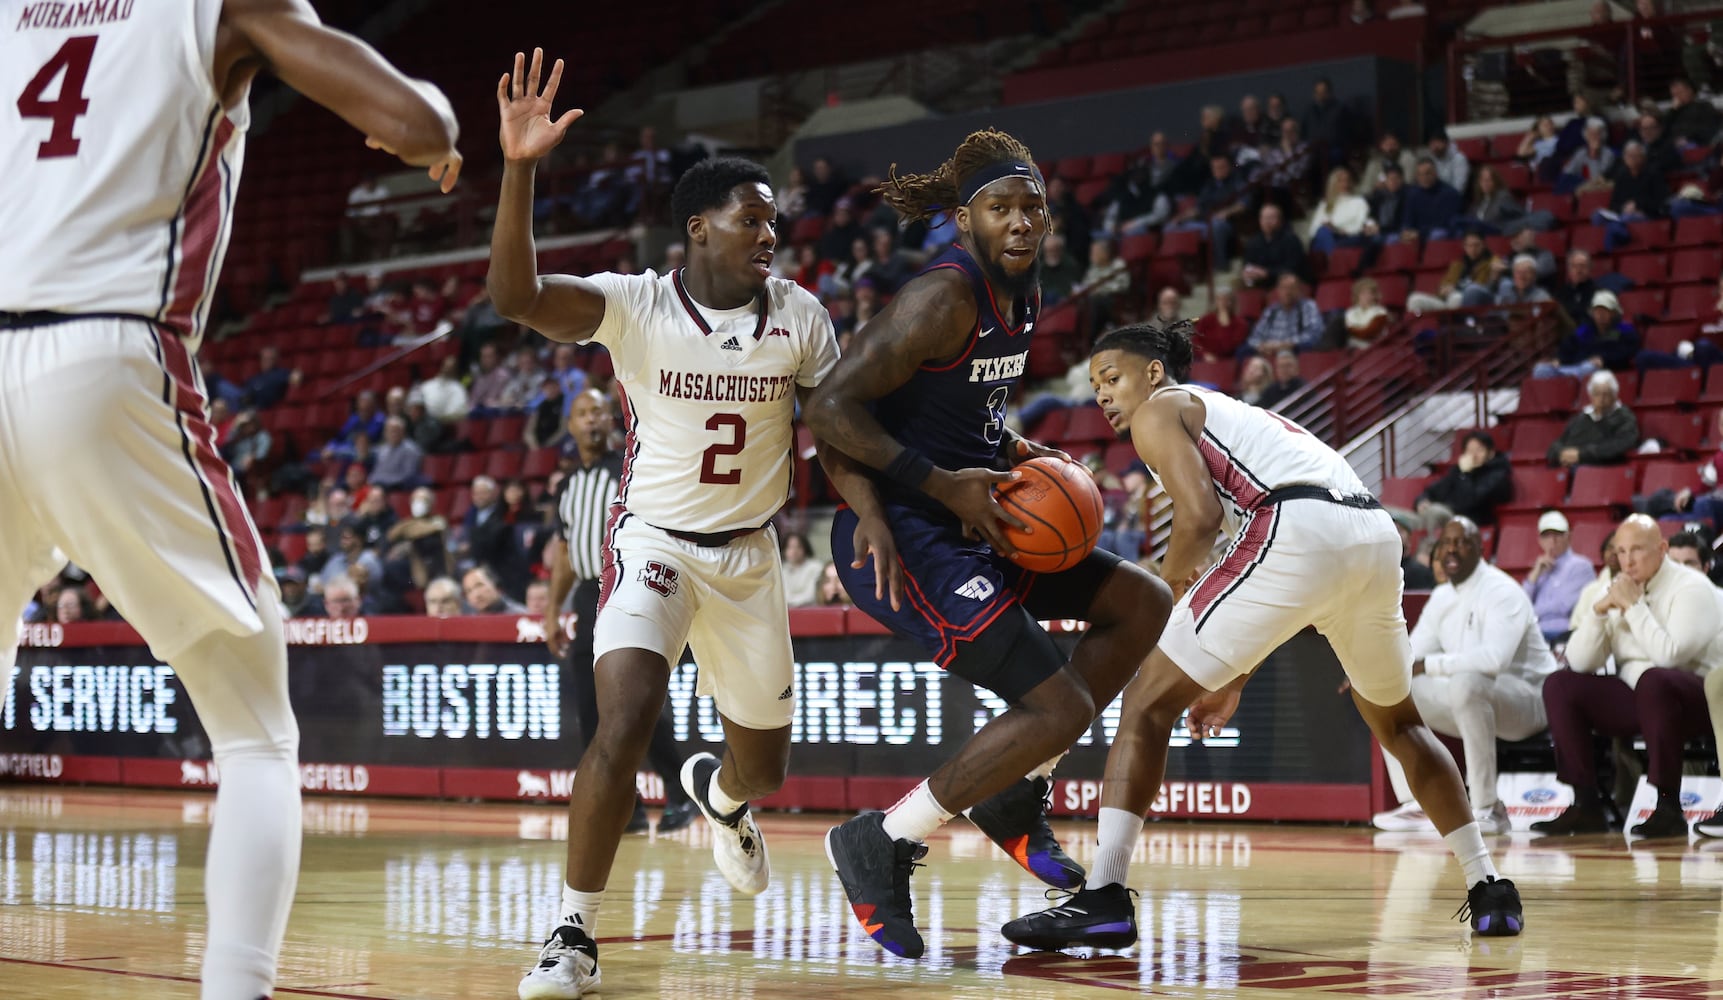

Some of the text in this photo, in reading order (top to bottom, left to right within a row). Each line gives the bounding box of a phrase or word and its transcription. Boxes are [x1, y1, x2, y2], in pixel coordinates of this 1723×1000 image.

[16, 34, 100, 161] 4
[699, 412, 747, 485] 2
[983, 385, 1009, 445] 3
[30, 664, 177, 734] SERVICE
[383, 663, 560, 740] BOSTON
[1064, 781, 1252, 814] SPGFIELD
